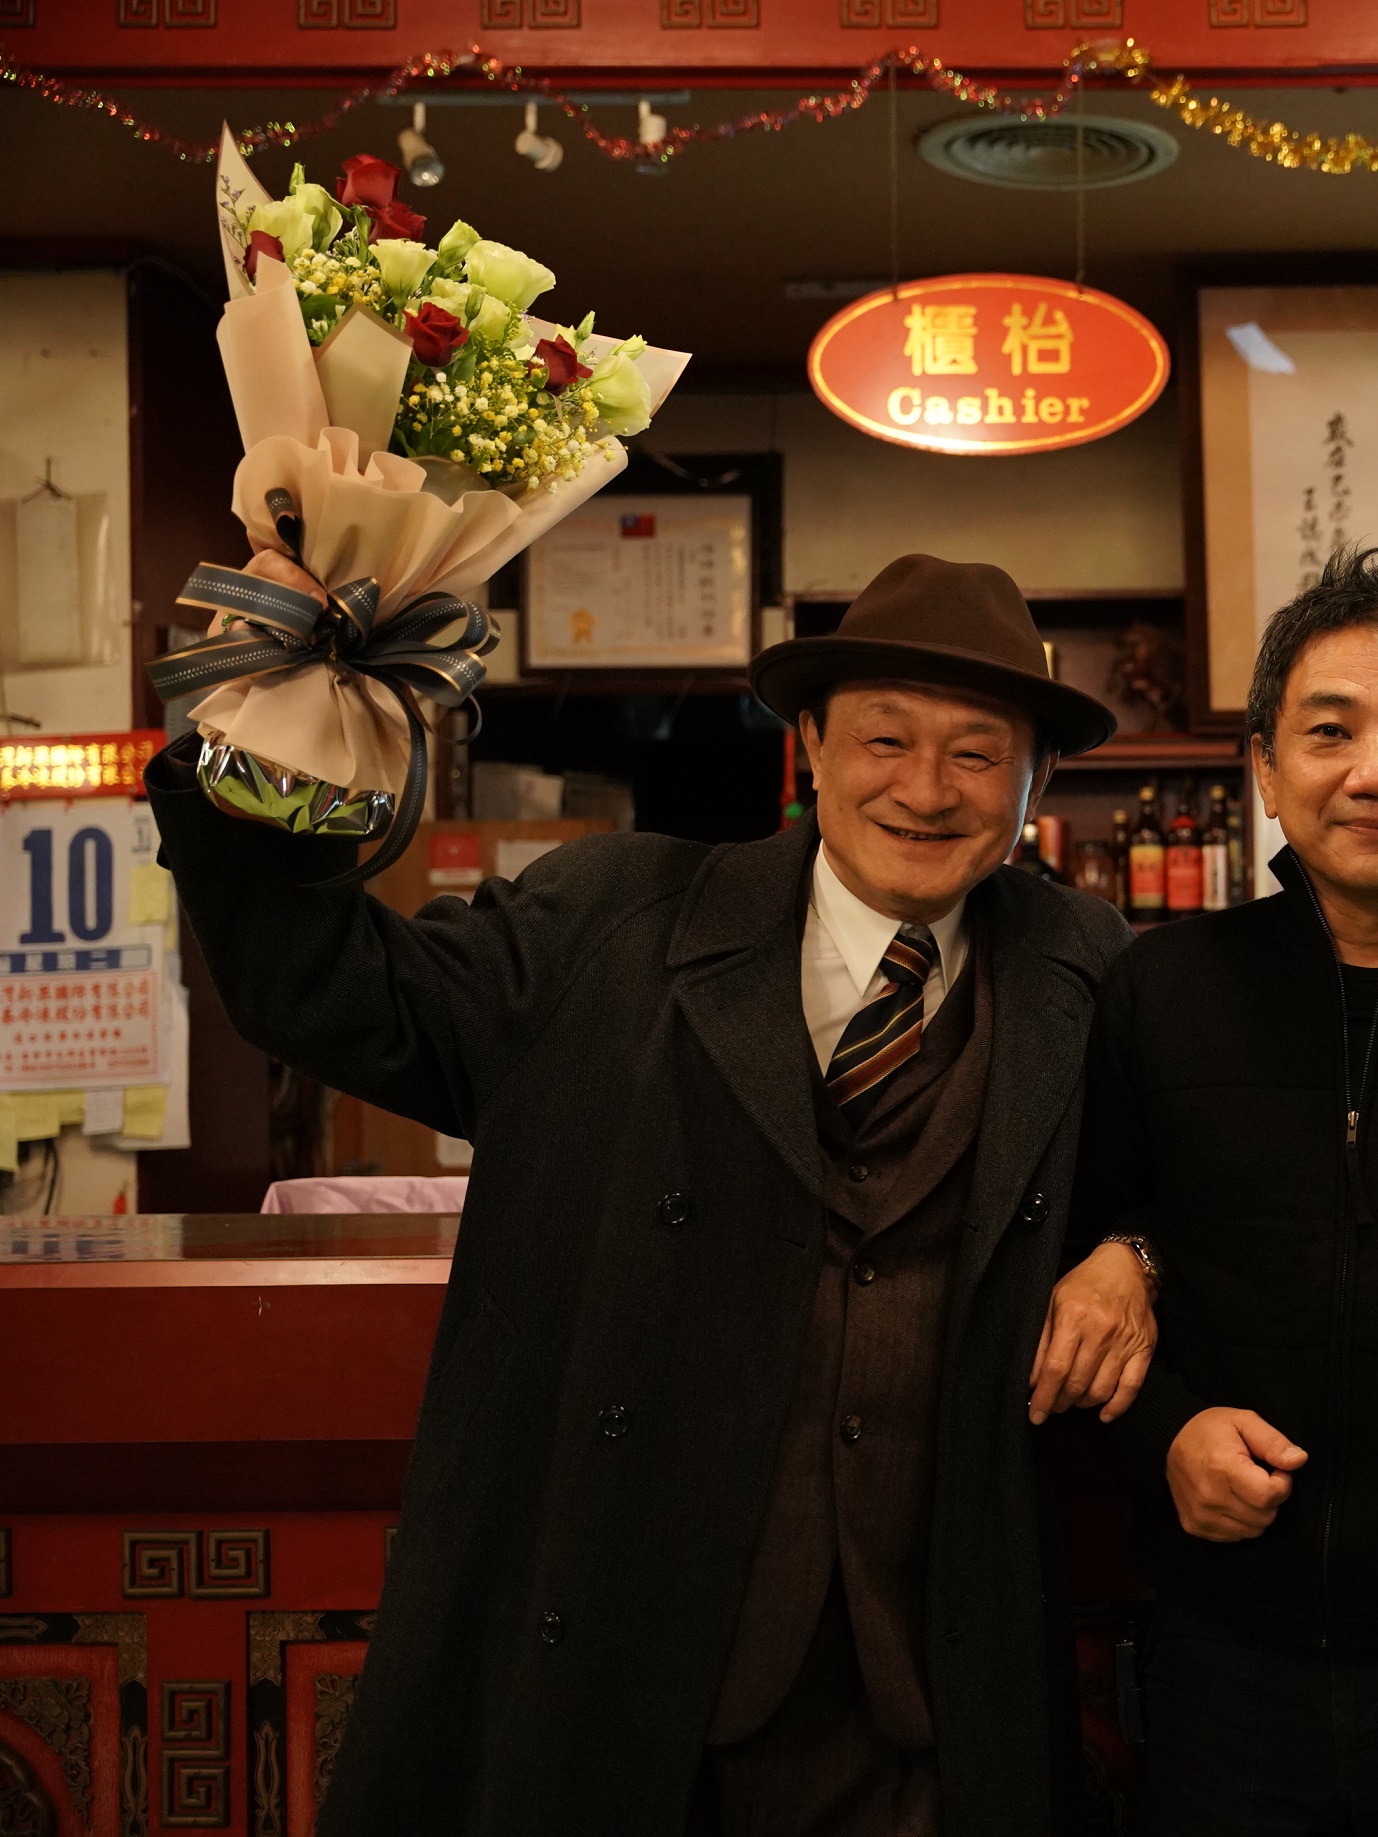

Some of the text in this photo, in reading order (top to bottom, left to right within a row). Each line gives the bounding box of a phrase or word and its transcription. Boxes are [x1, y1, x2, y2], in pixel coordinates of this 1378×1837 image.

[902, 301, 1075, 377] 櫃枱
[887, 386, 1091, 426] Cashier
[20, 826, 114, 944] 10
